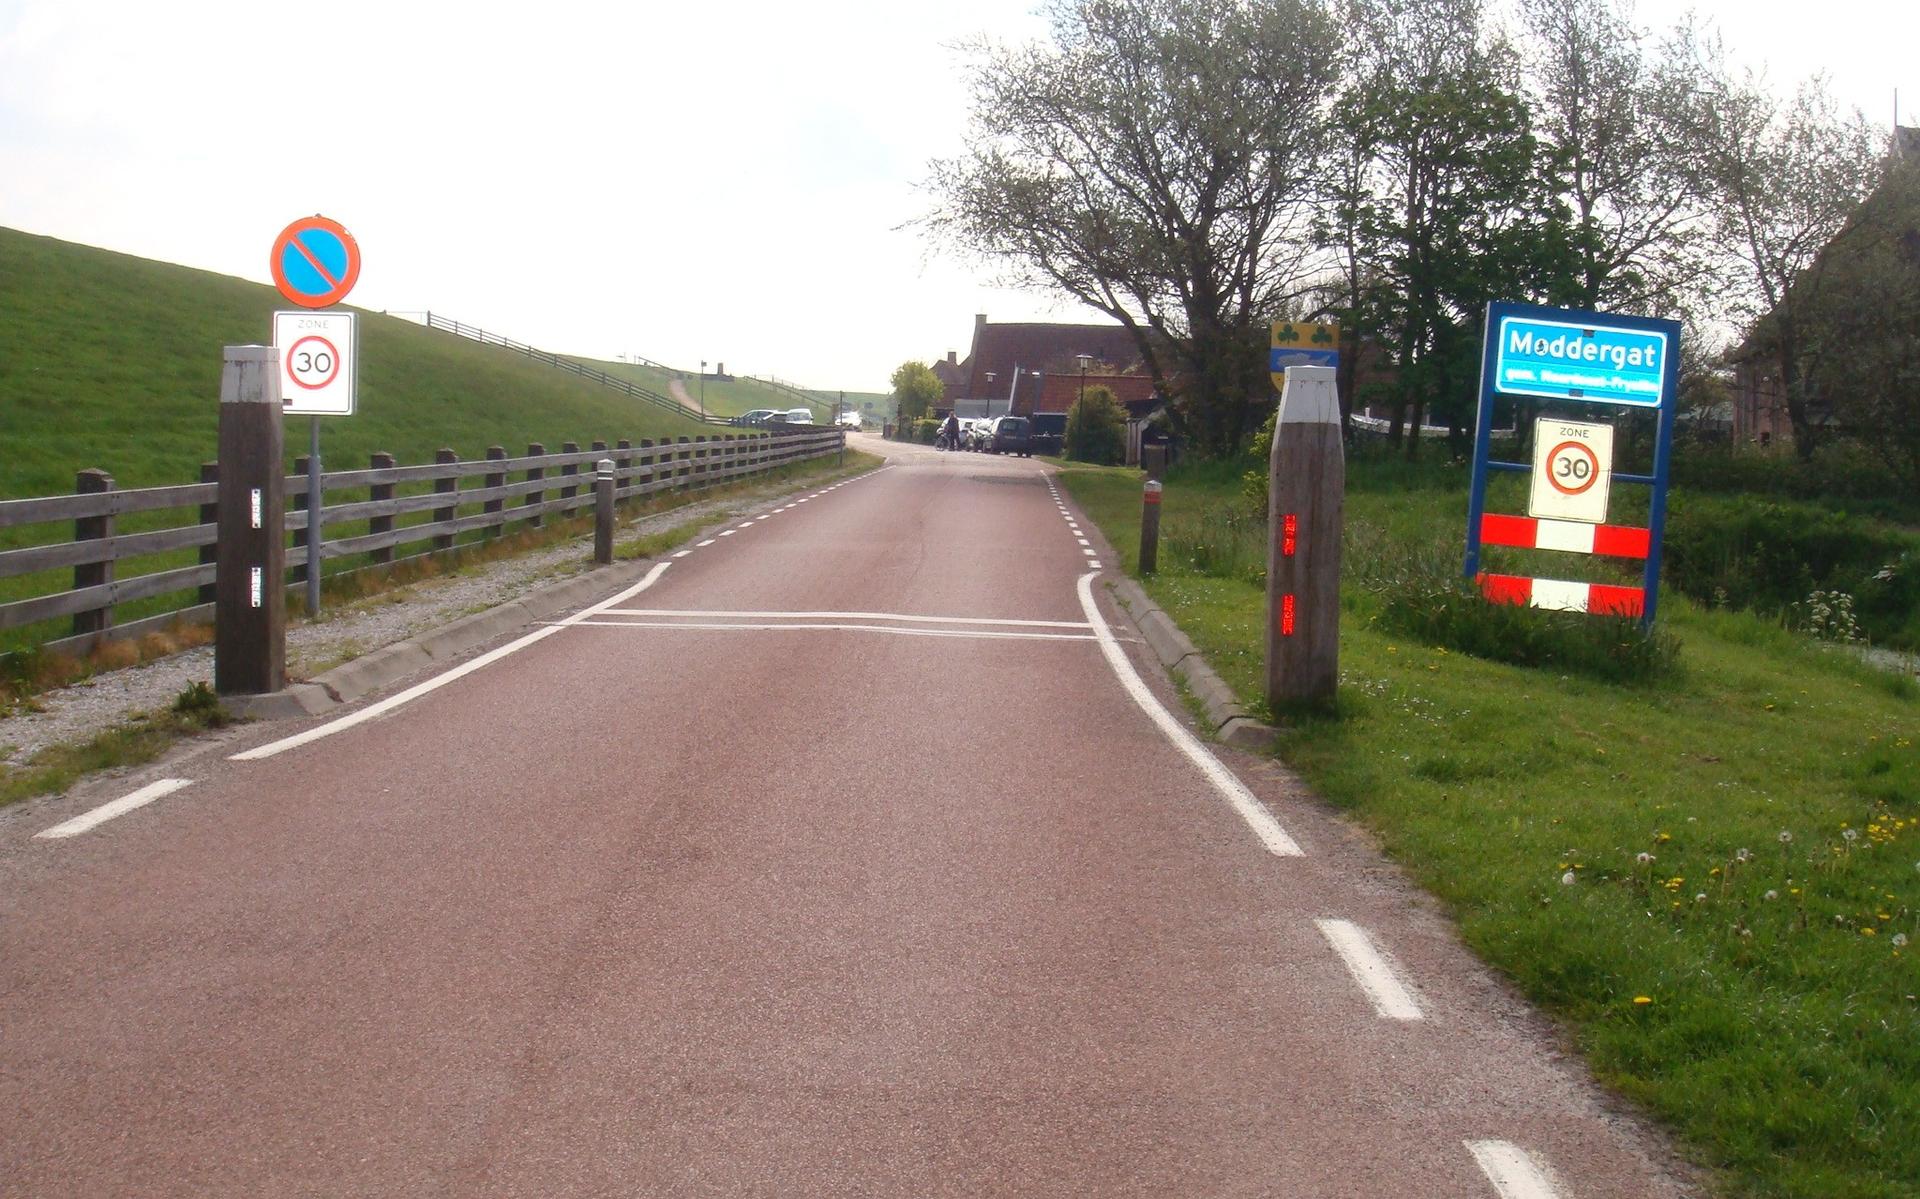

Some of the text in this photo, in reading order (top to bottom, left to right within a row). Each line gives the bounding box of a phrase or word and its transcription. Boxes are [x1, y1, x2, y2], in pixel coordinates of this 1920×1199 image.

[298, 320, 329, 329] ZONE
[1509, 330, 1656, 369] Moddergat
[297, 352, 331, 373] 30
[1559, 427, 1590, 438] ZONE
[1556, 457, 1589, 479] 30
